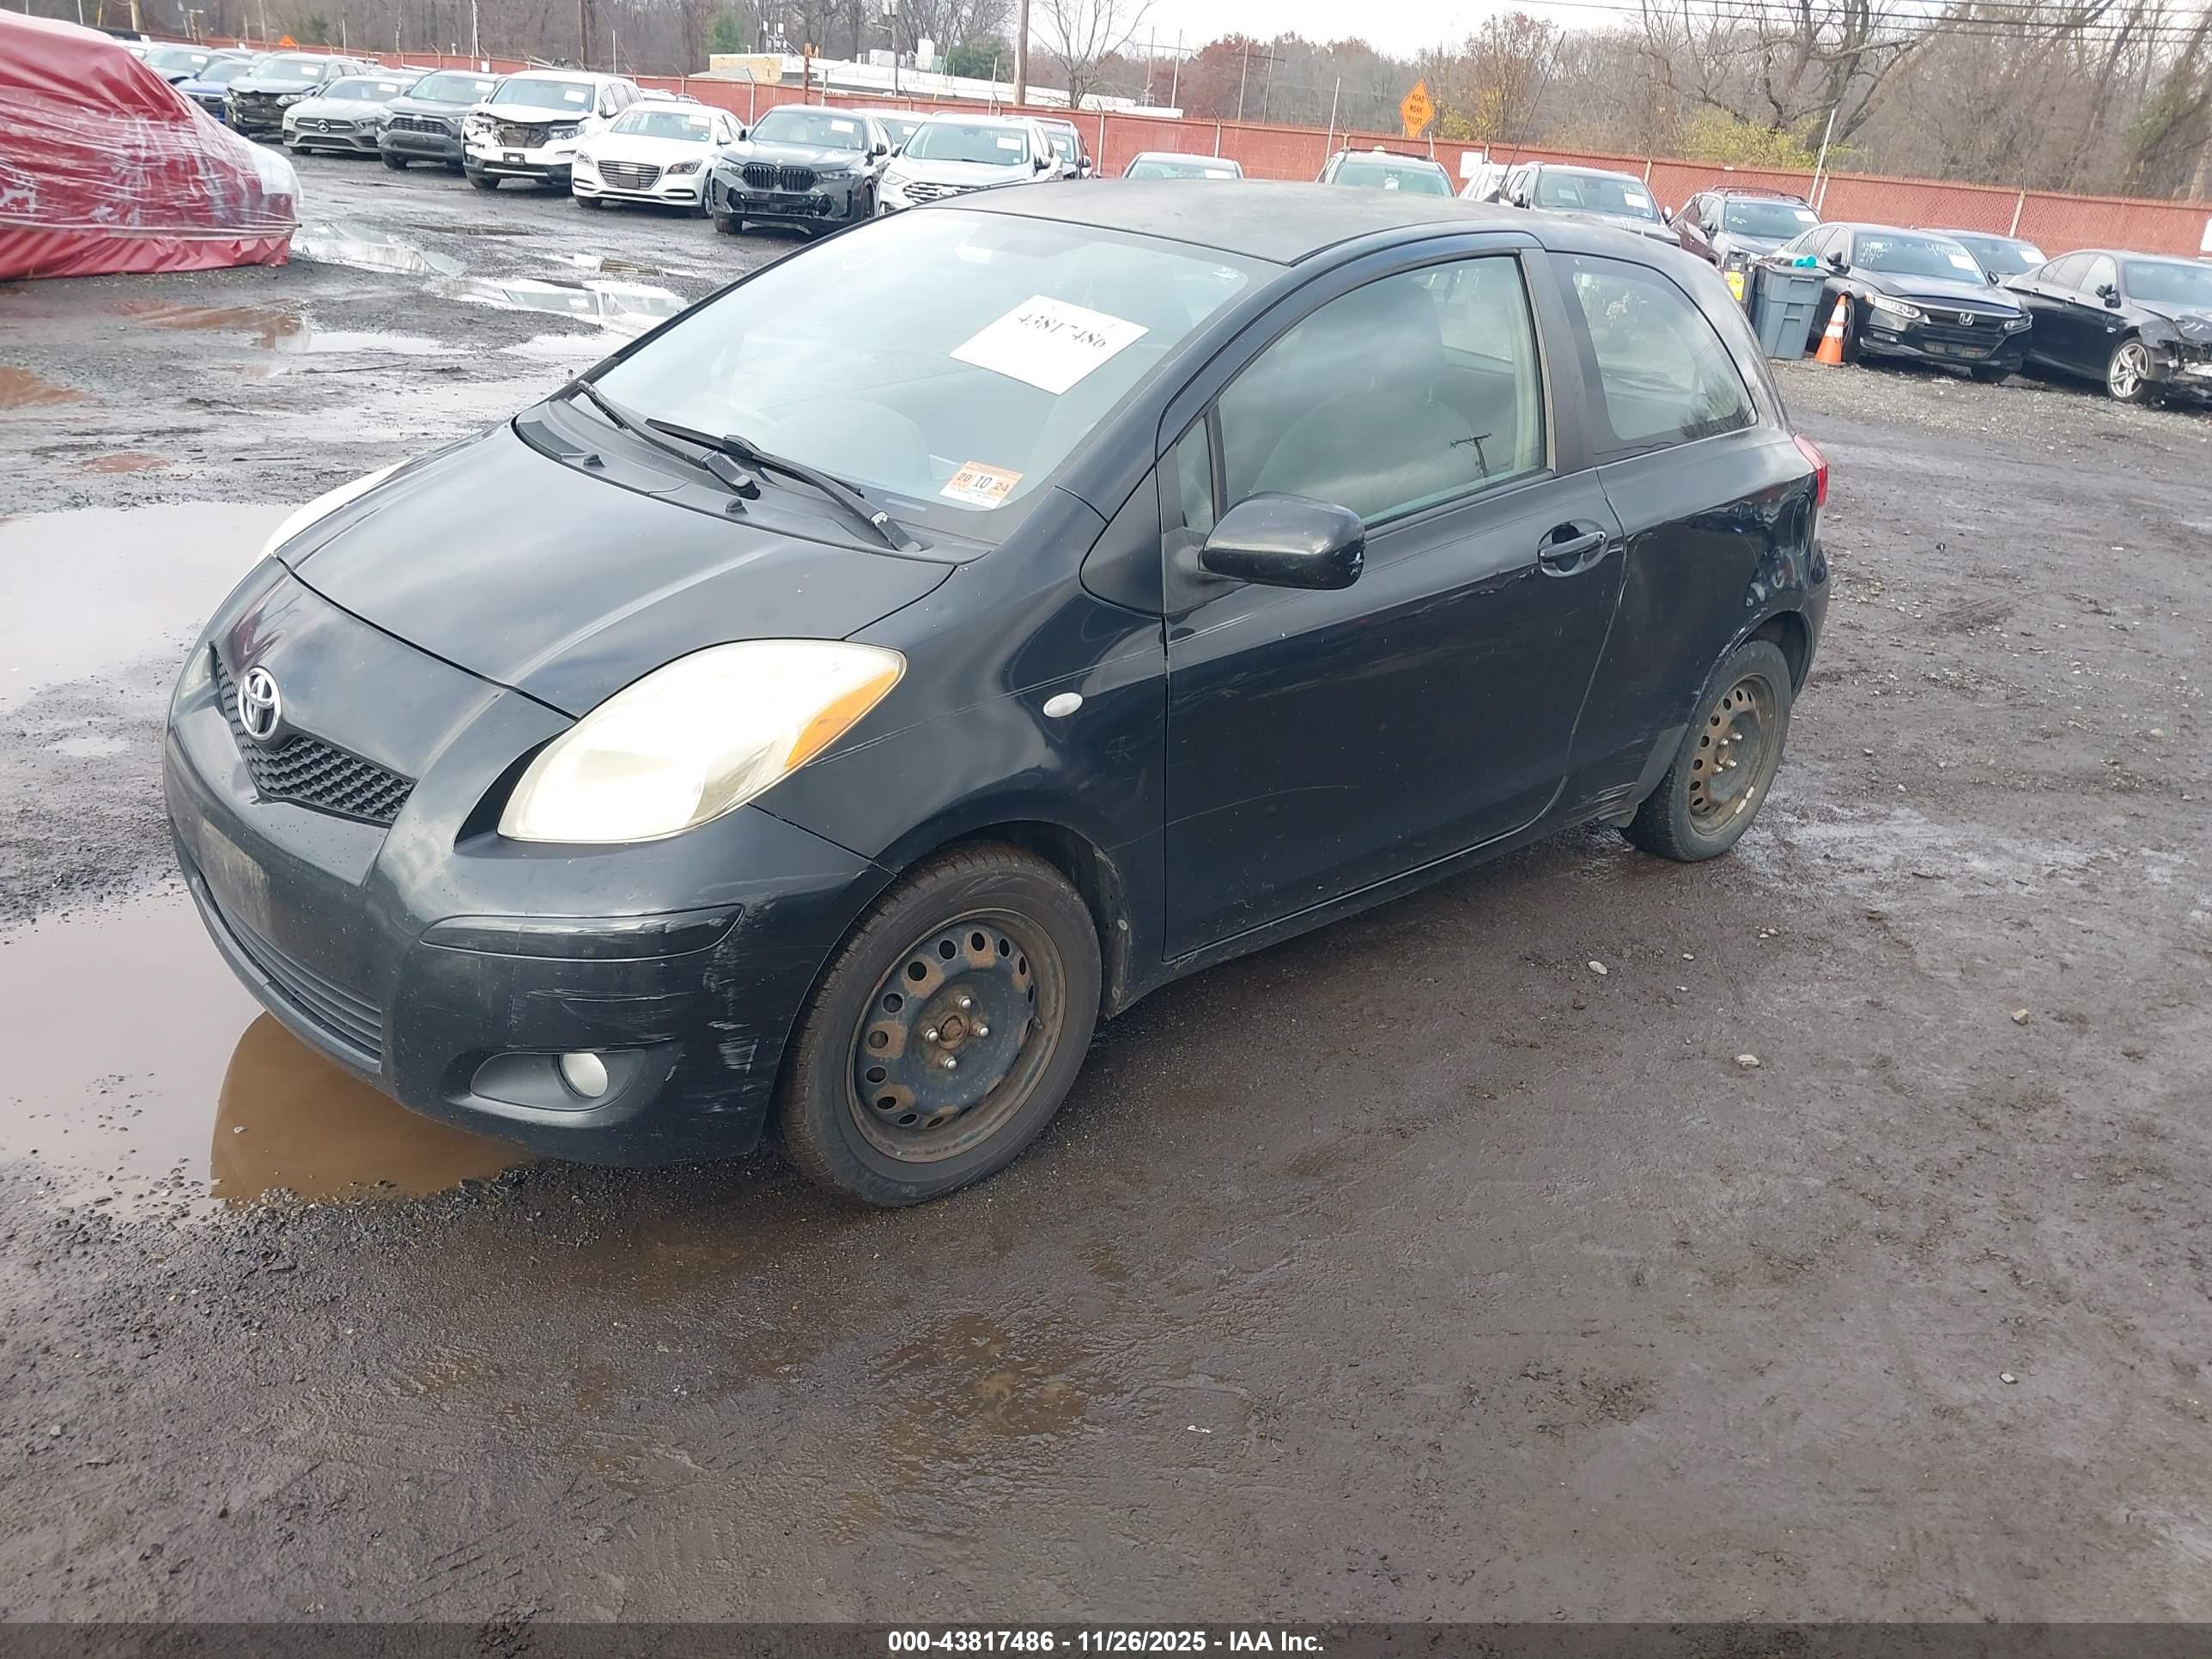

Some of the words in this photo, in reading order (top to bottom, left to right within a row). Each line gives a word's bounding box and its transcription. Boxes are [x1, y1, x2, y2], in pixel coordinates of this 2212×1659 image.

[1411, 93, 1425, 103] ROAD
[1409, 104, 1423, 116] WORK
[975, 475, 993, 489] 10
